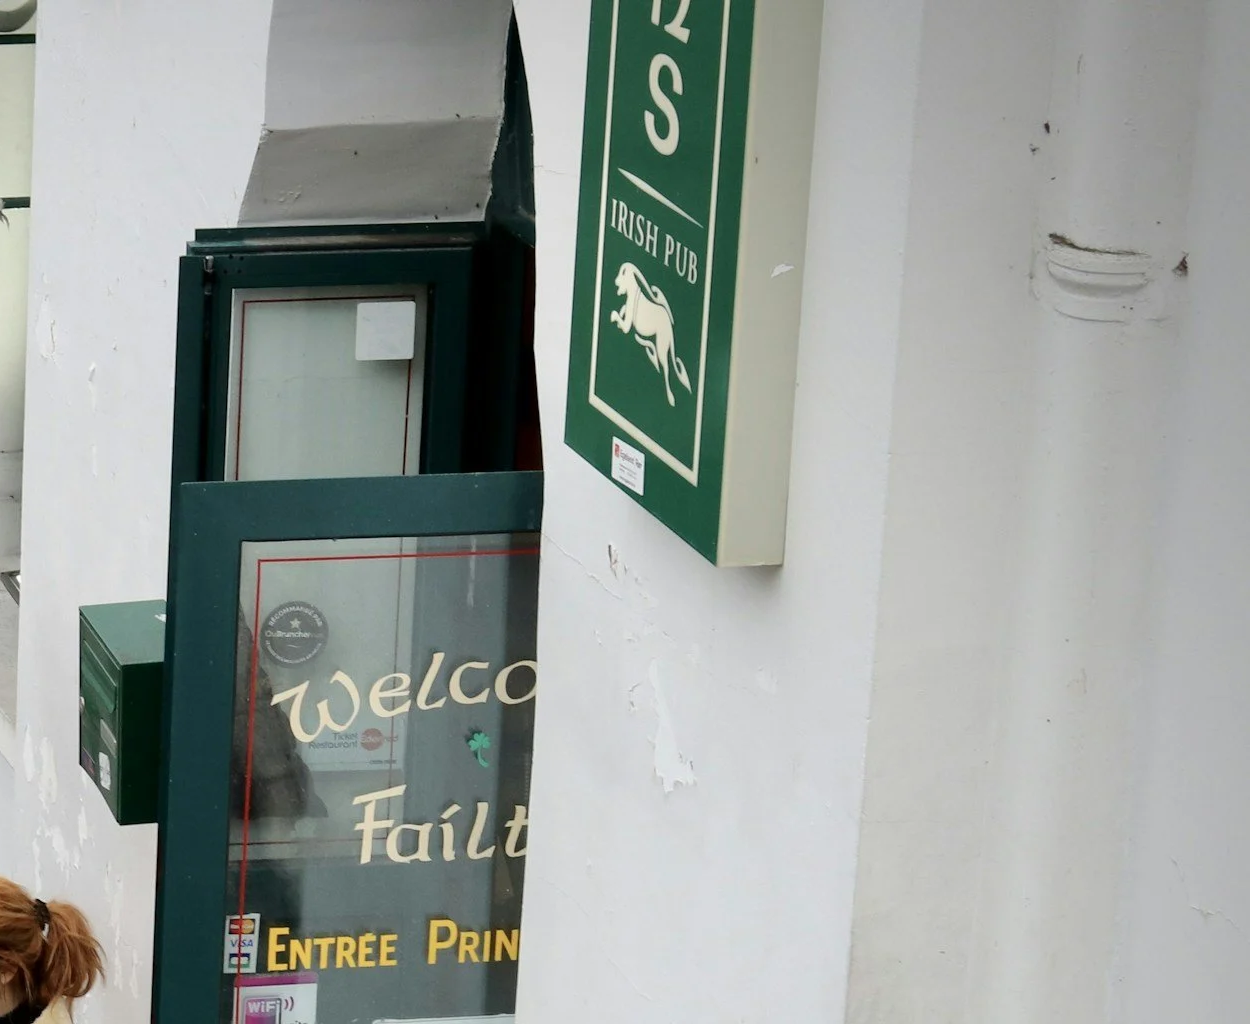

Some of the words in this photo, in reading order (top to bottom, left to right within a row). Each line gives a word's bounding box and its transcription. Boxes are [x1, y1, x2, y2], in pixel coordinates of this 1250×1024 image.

[611, 198, 659, 258] IRISH
[664, 233, 698, 285] PUB
[230, 939, 254, 947] VSA
